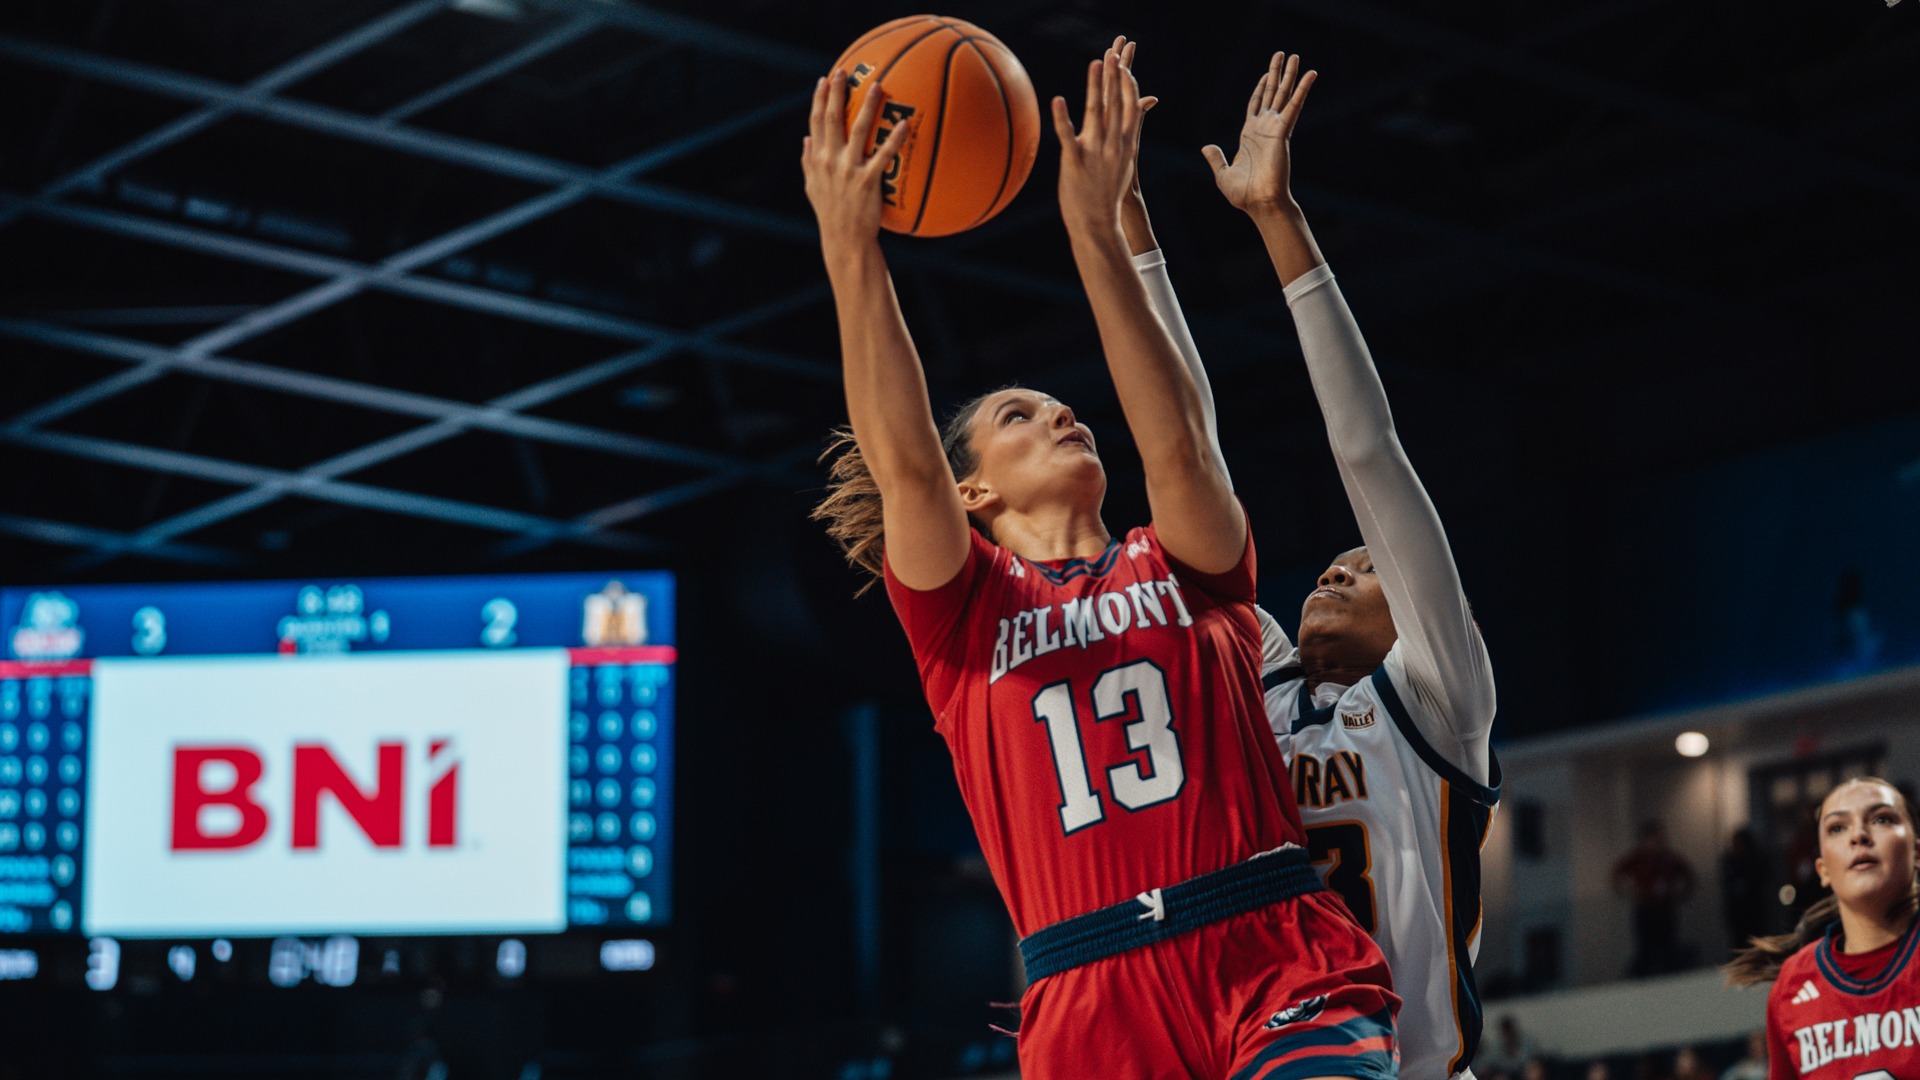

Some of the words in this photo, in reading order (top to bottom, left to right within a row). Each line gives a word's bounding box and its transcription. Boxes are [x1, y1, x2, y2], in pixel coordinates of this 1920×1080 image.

[989, 572, 1193, 686] BELMONT
[1031, 657, 1188, 837] 13
[1340, 705, 1376, 728] VALLEY
[1288, 750, 1369, 808] RAY
